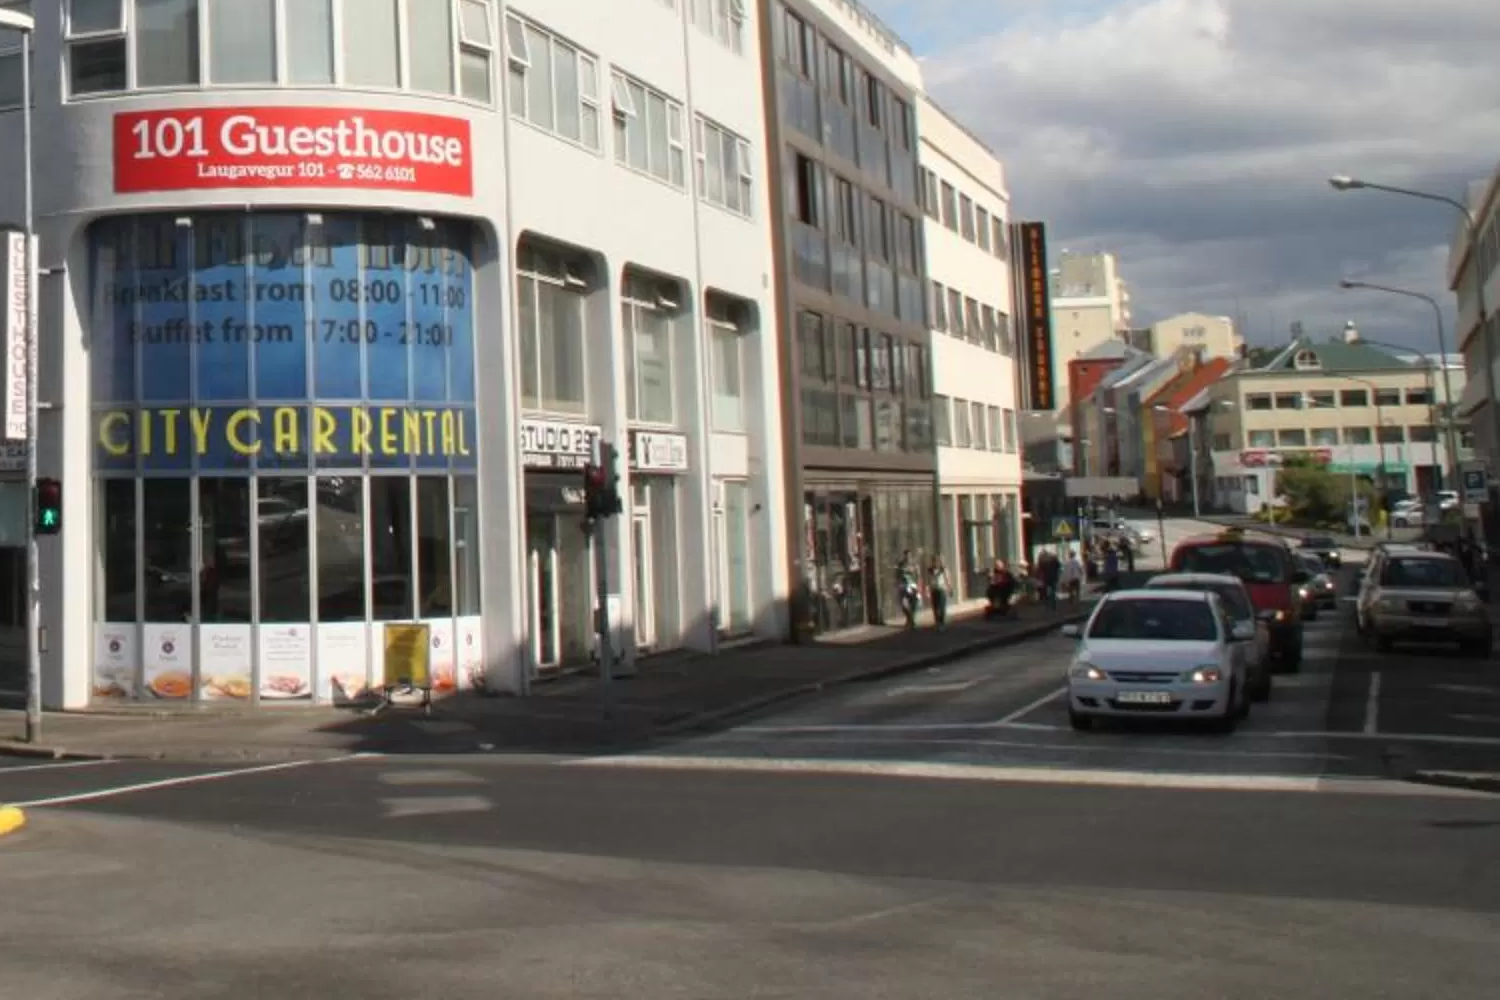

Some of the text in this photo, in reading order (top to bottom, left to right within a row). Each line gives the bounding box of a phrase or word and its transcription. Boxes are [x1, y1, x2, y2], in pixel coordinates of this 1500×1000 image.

[131, 115, 463, 167] 101 Guesthouse
[197, 162, 294, 179] Laugavegur
[299, 162, 325, 178] 101
[249, 278, 315, 303] rom
[329, 279, 400, 305] 08:00
[221, 318, 294, 344] from
[99, 407, 470, 457] CITY CAR RENTAL
